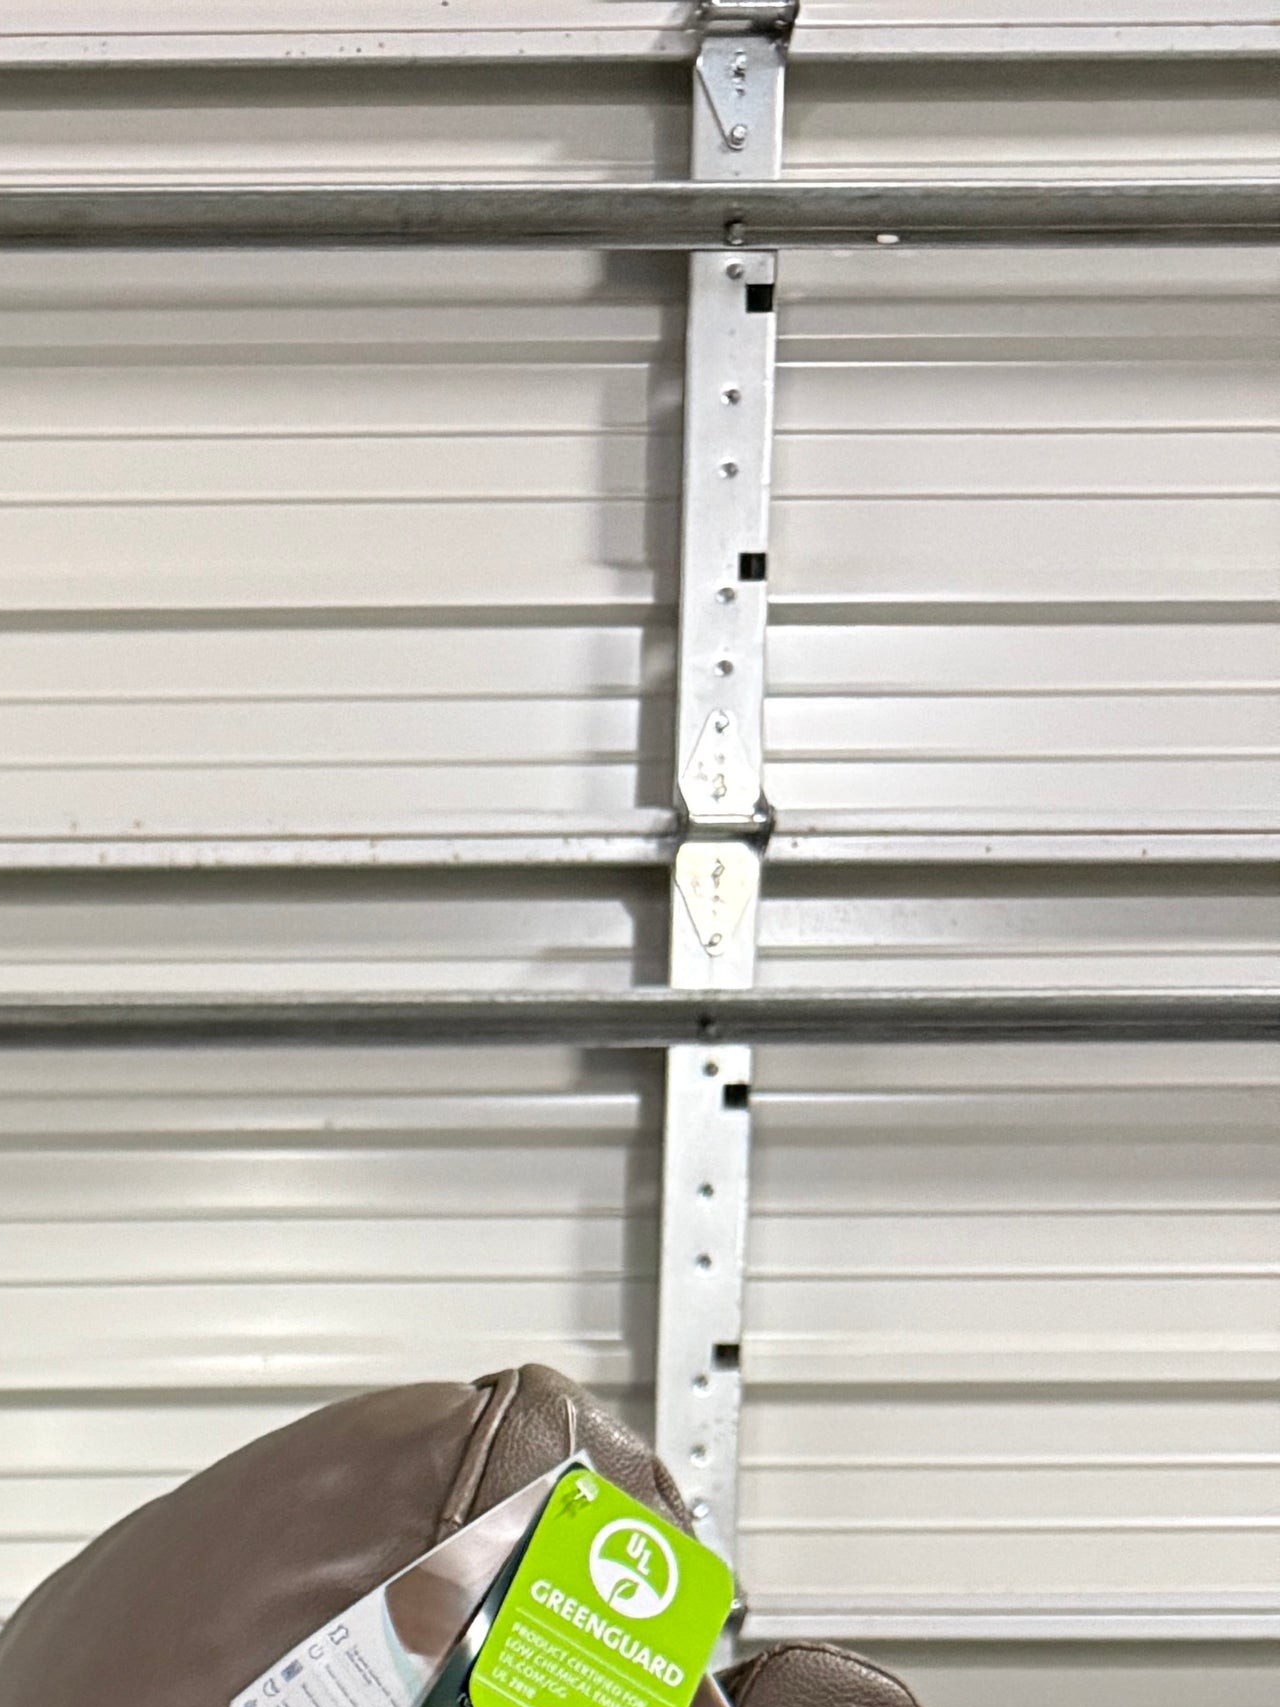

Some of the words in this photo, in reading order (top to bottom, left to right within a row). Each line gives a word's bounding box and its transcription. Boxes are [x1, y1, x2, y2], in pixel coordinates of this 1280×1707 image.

[505, 1637, 534, 1660] LOW
[533, 1655, 591, 1697] CHEMICAL
[512, 1622, 568, 1661] PRODUCT
[567, 1657, 623, 1698] CERTIFIED
[530, 1579, 685, 1687] GREENGUARD
[492, 1667, 508, 1682] UL
